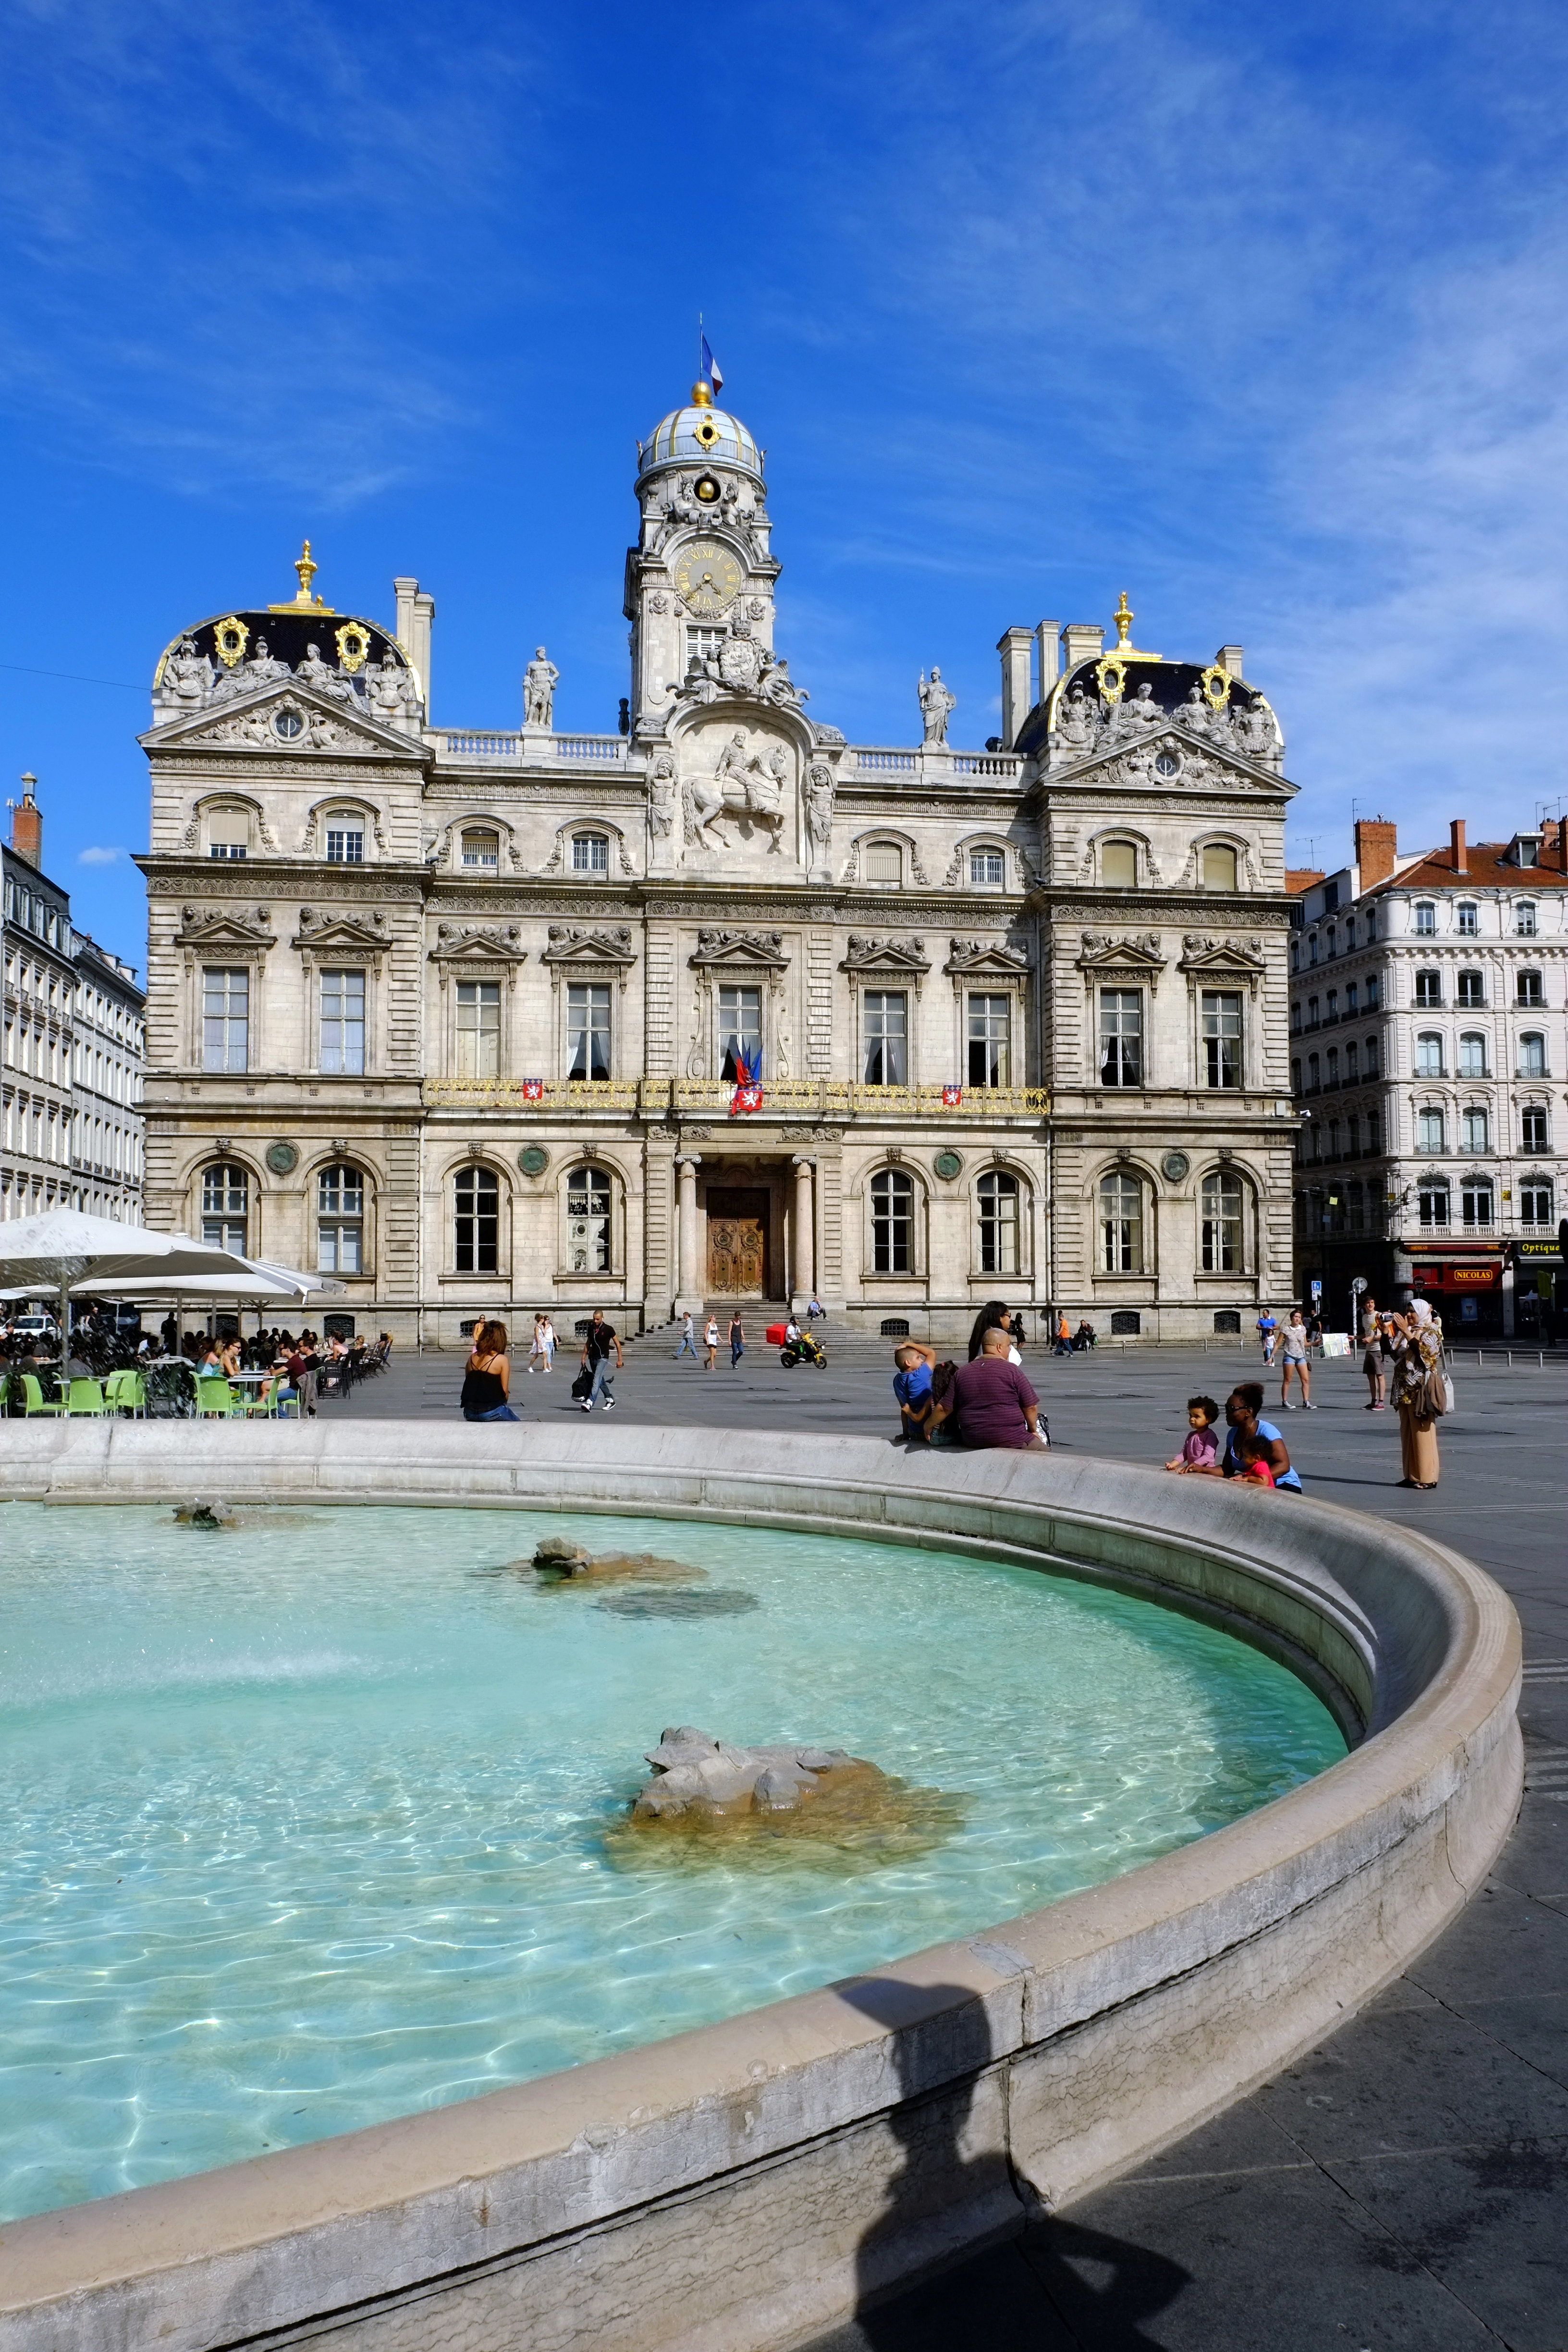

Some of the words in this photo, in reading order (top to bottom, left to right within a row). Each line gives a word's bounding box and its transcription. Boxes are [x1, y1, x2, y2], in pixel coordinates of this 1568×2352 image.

[702, 550, 713, 558] XII
[682, 560, 692, 569] X
[1522, 1243, 1560, 1254] Optique
